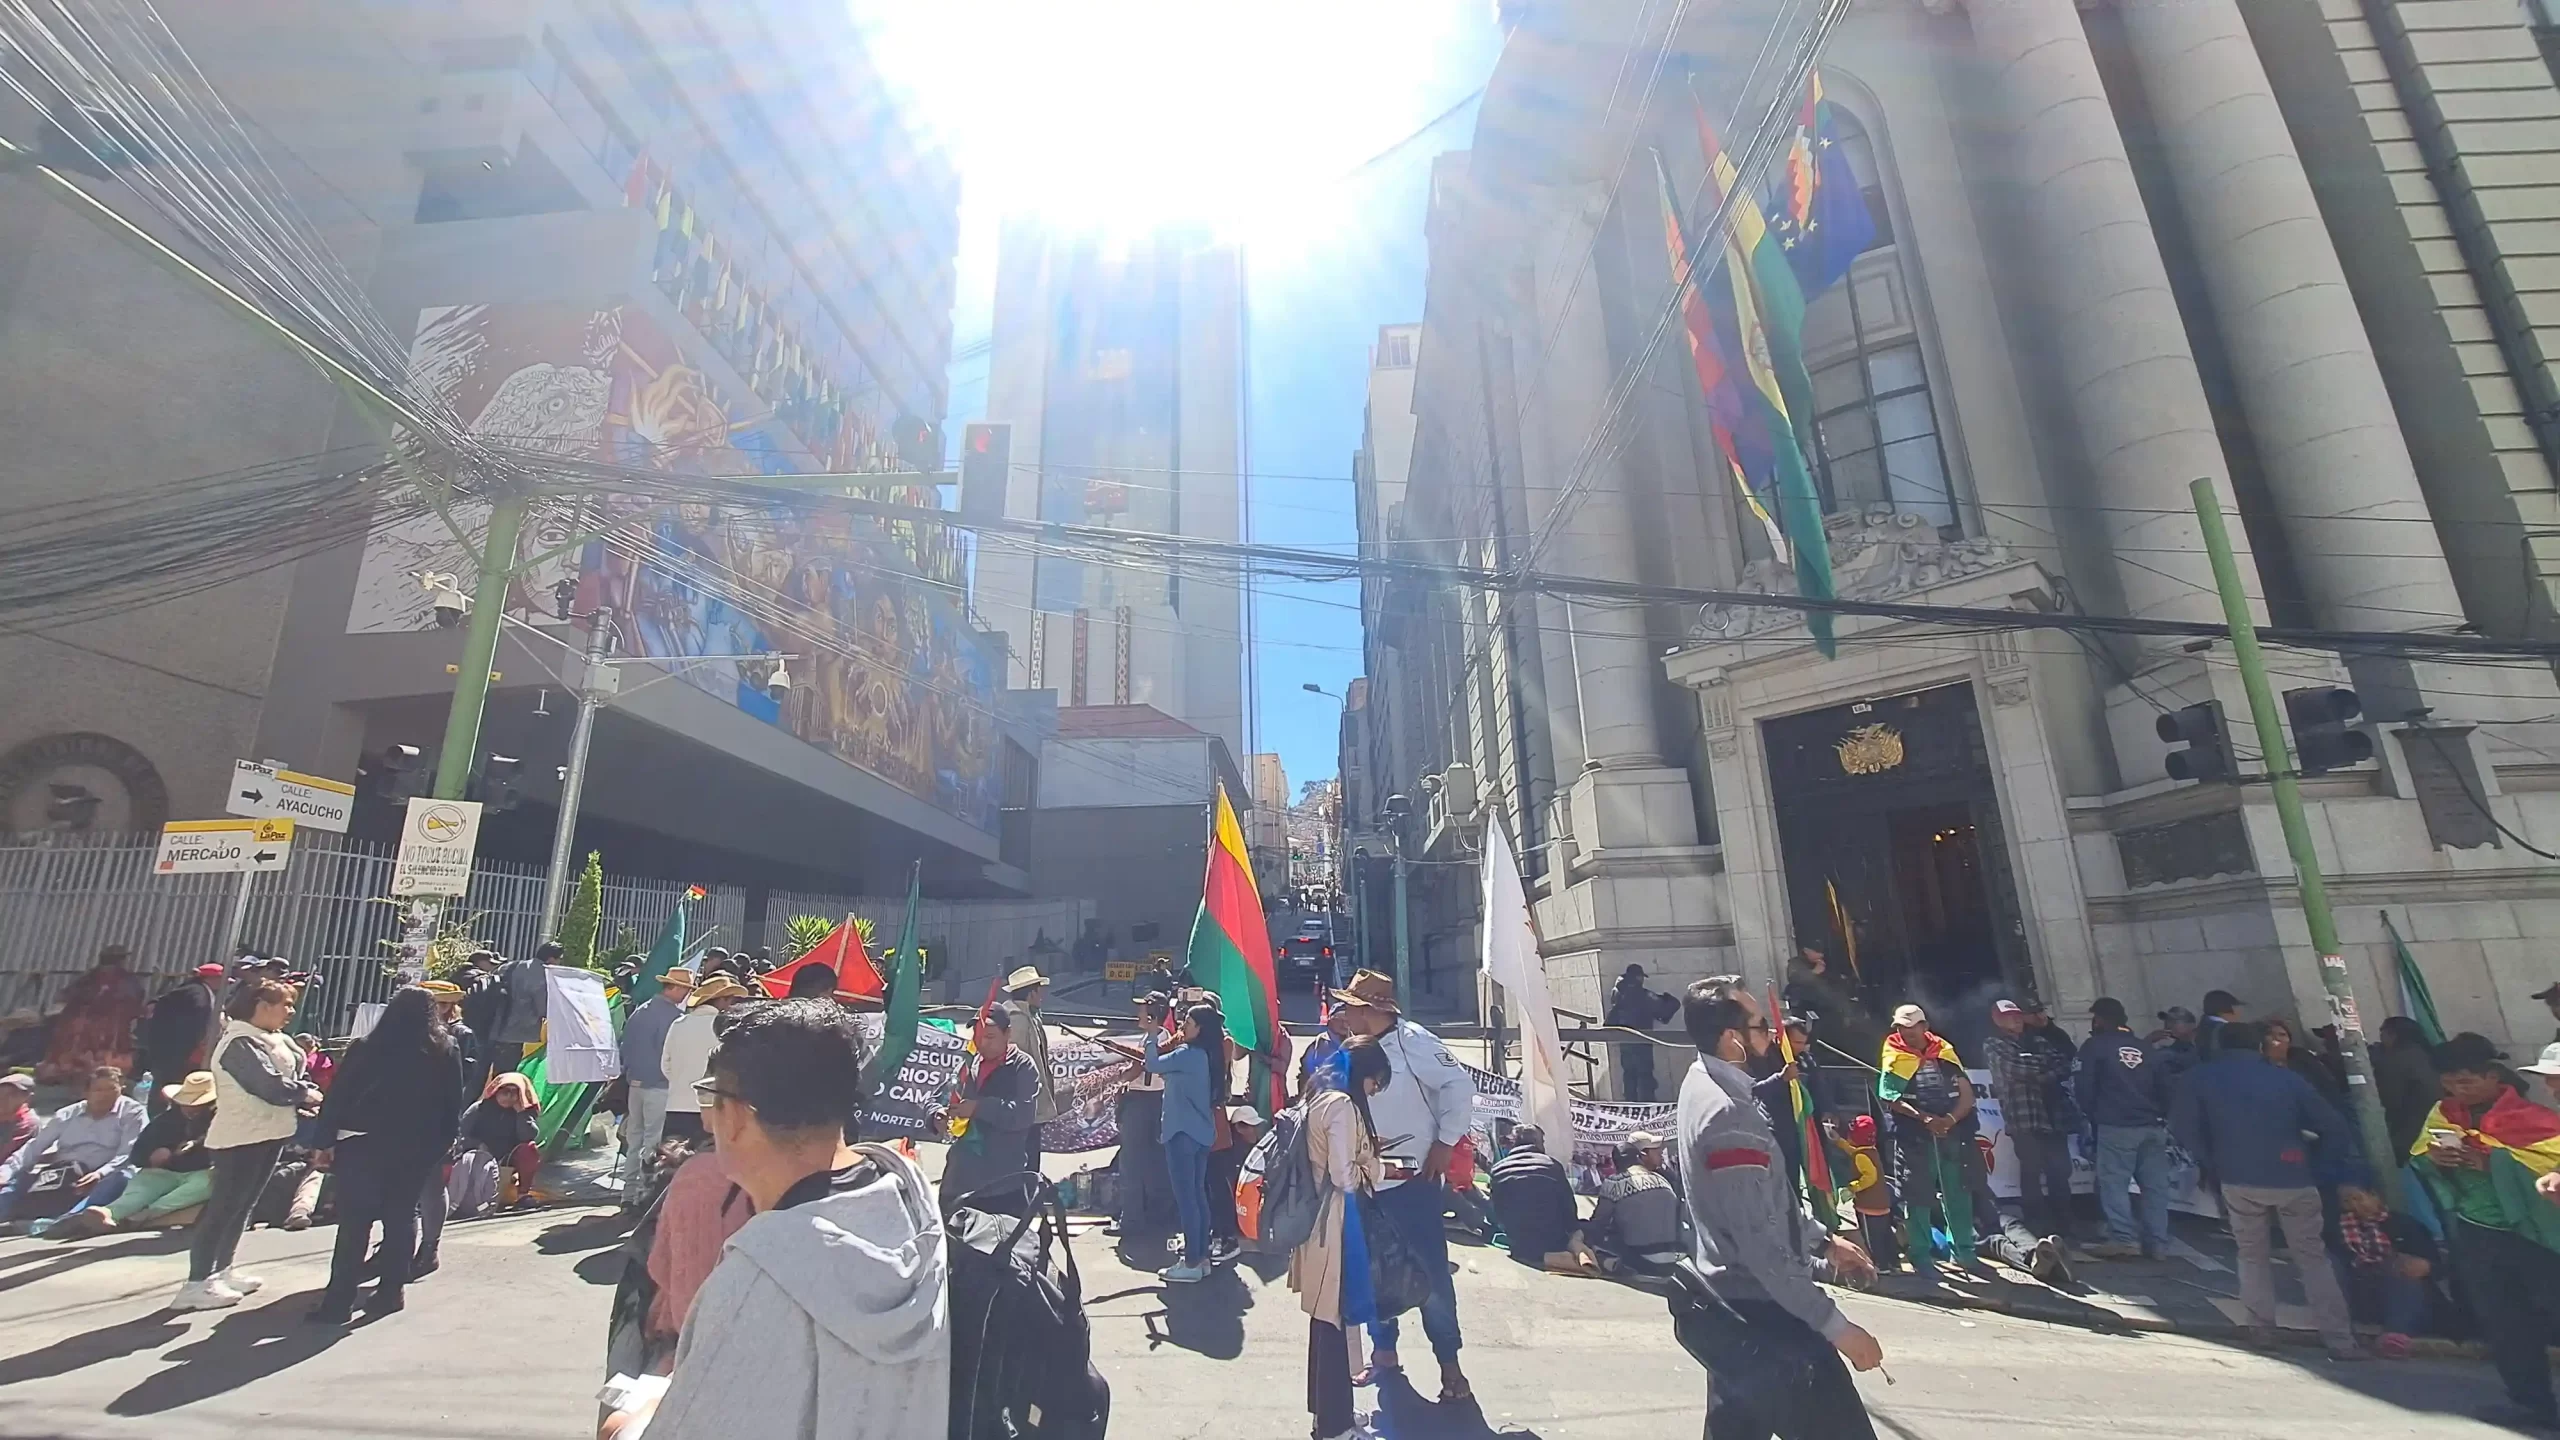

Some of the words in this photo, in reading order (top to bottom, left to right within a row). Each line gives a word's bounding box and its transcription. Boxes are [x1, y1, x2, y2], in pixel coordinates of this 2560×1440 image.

[281, 784, 313, 799] CALLE:
[276, 798, 343, 820] AYACUCHO
[170, 835, 204, 845] CALLE:
[166, 847, 240, 861] MERCADO
[402, 845, 415, 862] NO
[417, 846, 442, 863] TOQUE
[870, 1111, 913, 1127] NORTE
